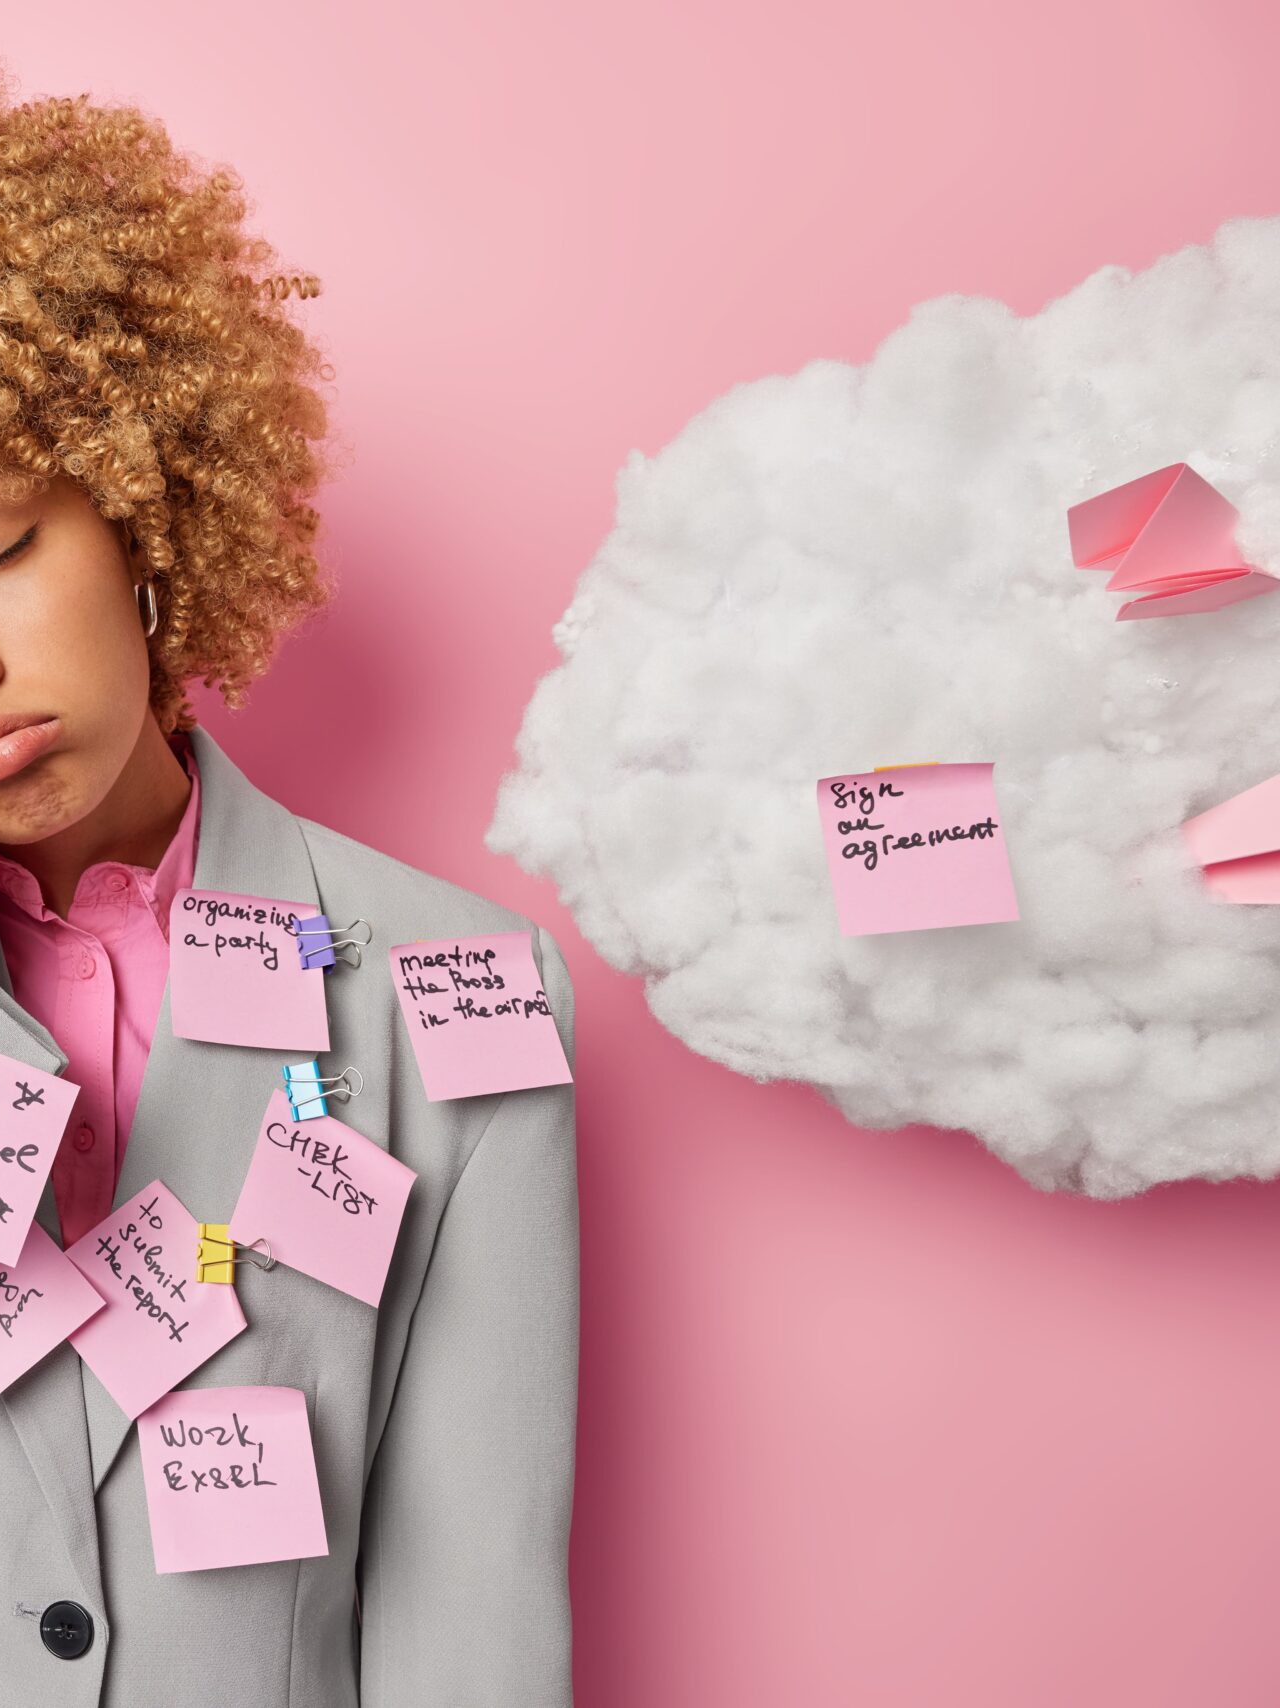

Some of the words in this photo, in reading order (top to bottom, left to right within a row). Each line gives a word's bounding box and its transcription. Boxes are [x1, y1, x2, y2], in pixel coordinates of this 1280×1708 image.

[837, 817, 885, 835] an
[842, 817, 999, 871] agreement
[182, 896, 299, 937] organizing
[184, 933, 209, 947] a
[215, 931, 279, 971] party
[399, 945, 496, 976] meeting
[403, 976, 449, 1001] the
[419, 1010, 449, 1030] in
[453, 996, 493, 1020] the
[138, 1196, 163, 1229] to
[119, 1223, 187, 1302] submit
[95, 1236, 123, 1280] the
[125, 1274, 190, 1343] report
